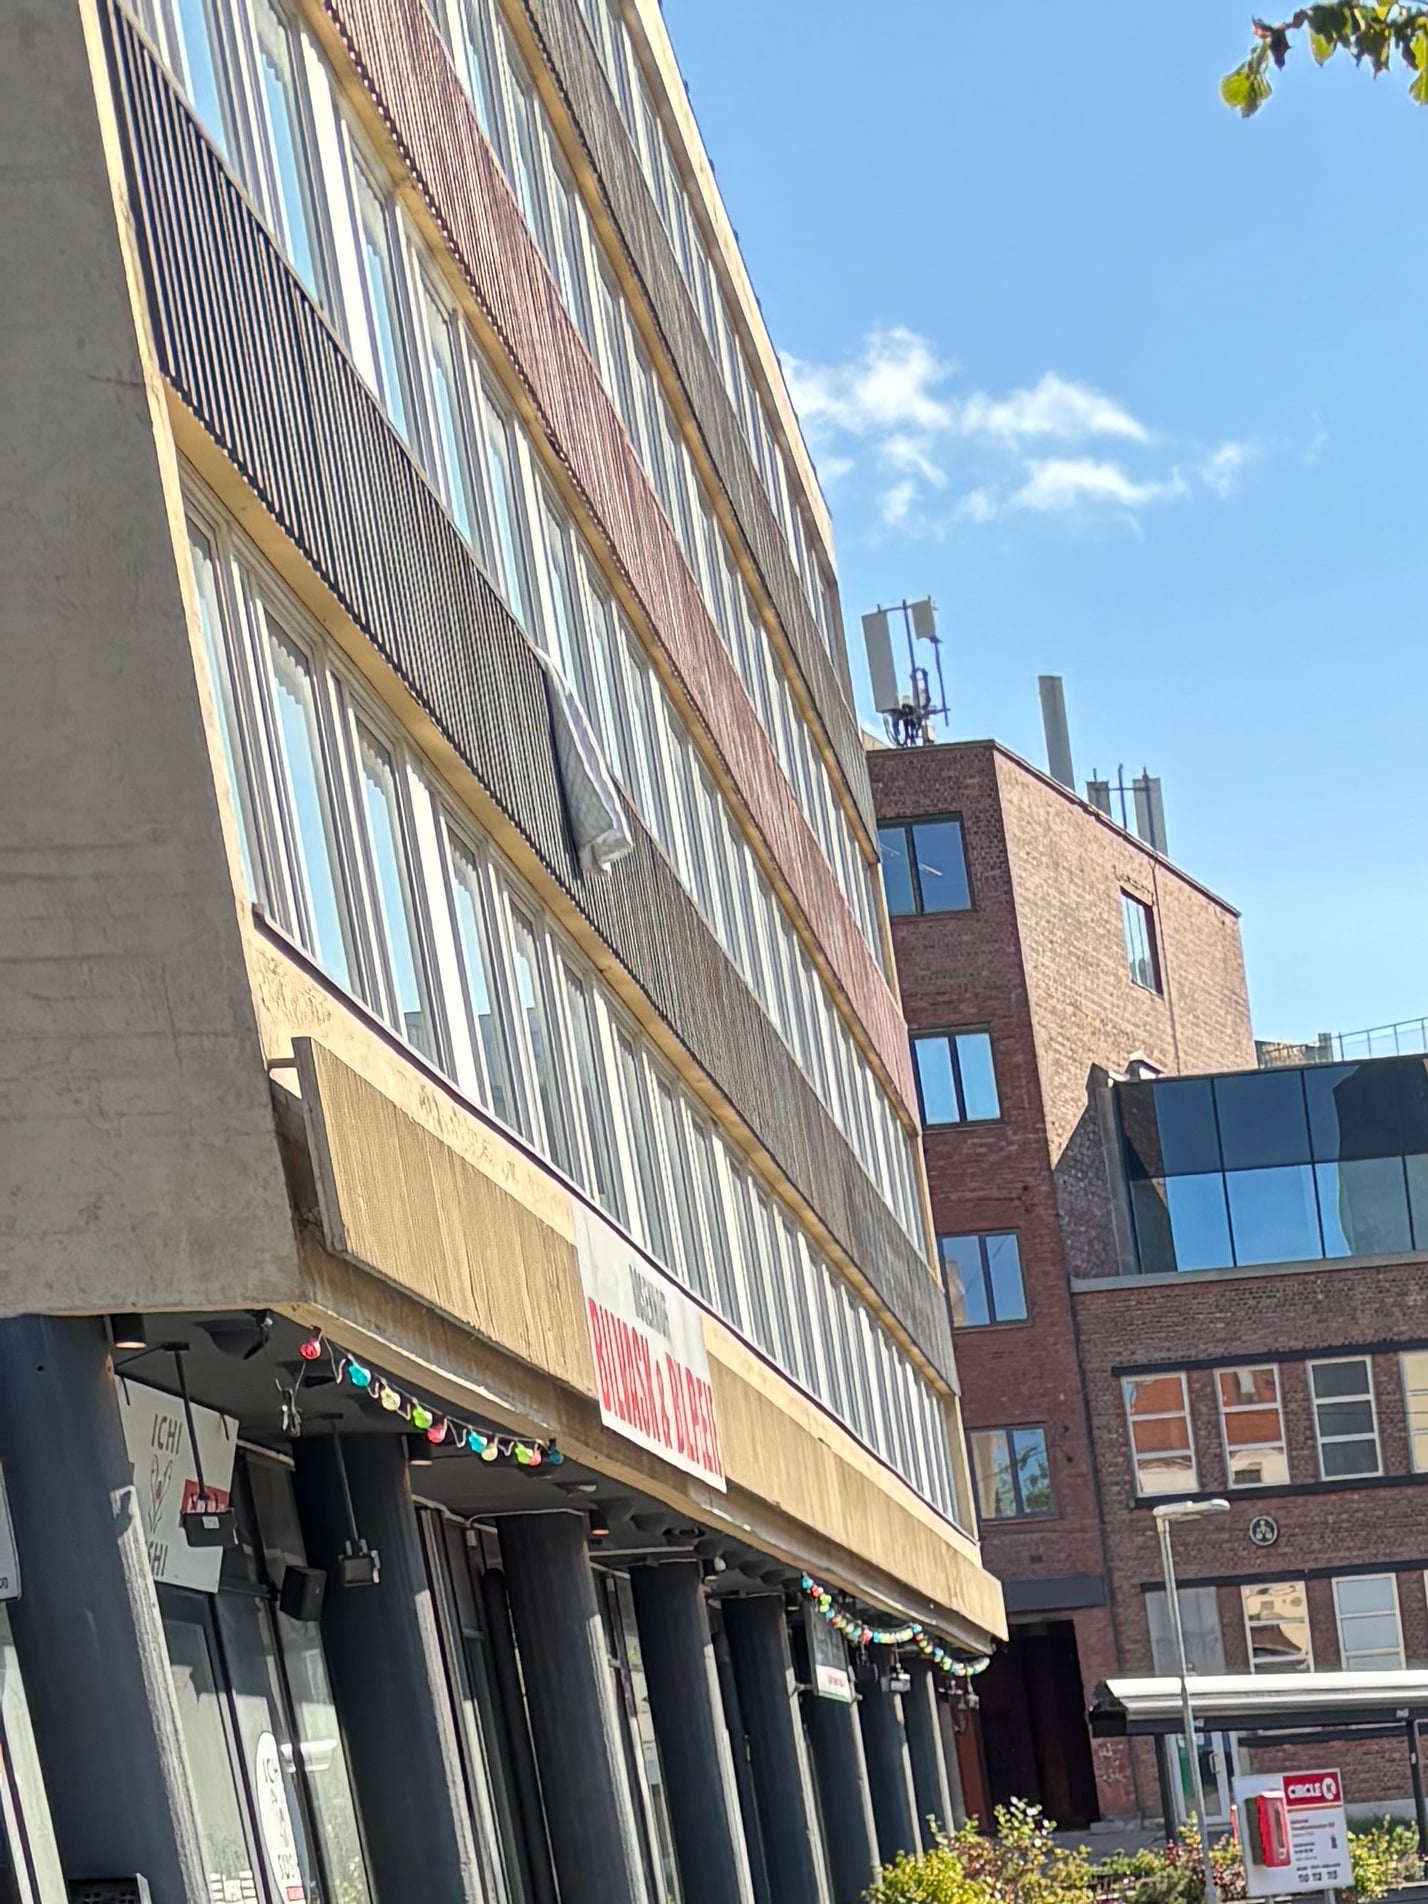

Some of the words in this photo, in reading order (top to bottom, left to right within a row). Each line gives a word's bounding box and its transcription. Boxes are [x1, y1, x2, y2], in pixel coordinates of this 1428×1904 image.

[588, 1296, 661, 1443] BILVASK
[655, 1359, 672, 1449] &
[151, 1414, 183, 1455] ICHI
